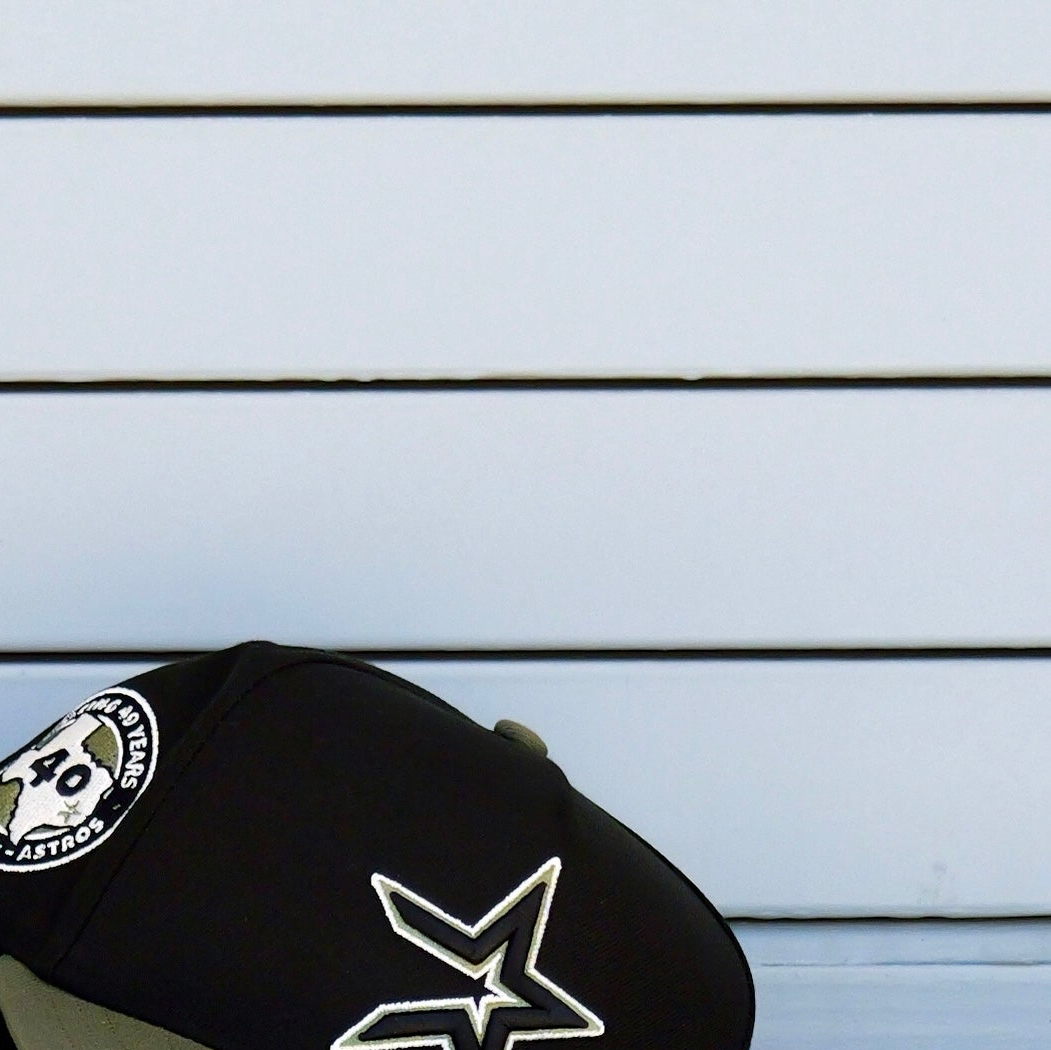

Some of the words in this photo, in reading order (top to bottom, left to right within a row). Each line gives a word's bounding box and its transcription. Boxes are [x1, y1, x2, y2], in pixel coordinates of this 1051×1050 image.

[29, 748, 92, 797] 40
[120, 724, 148, 789] YEARS
[16, 817, 104, 861] ASTROS
